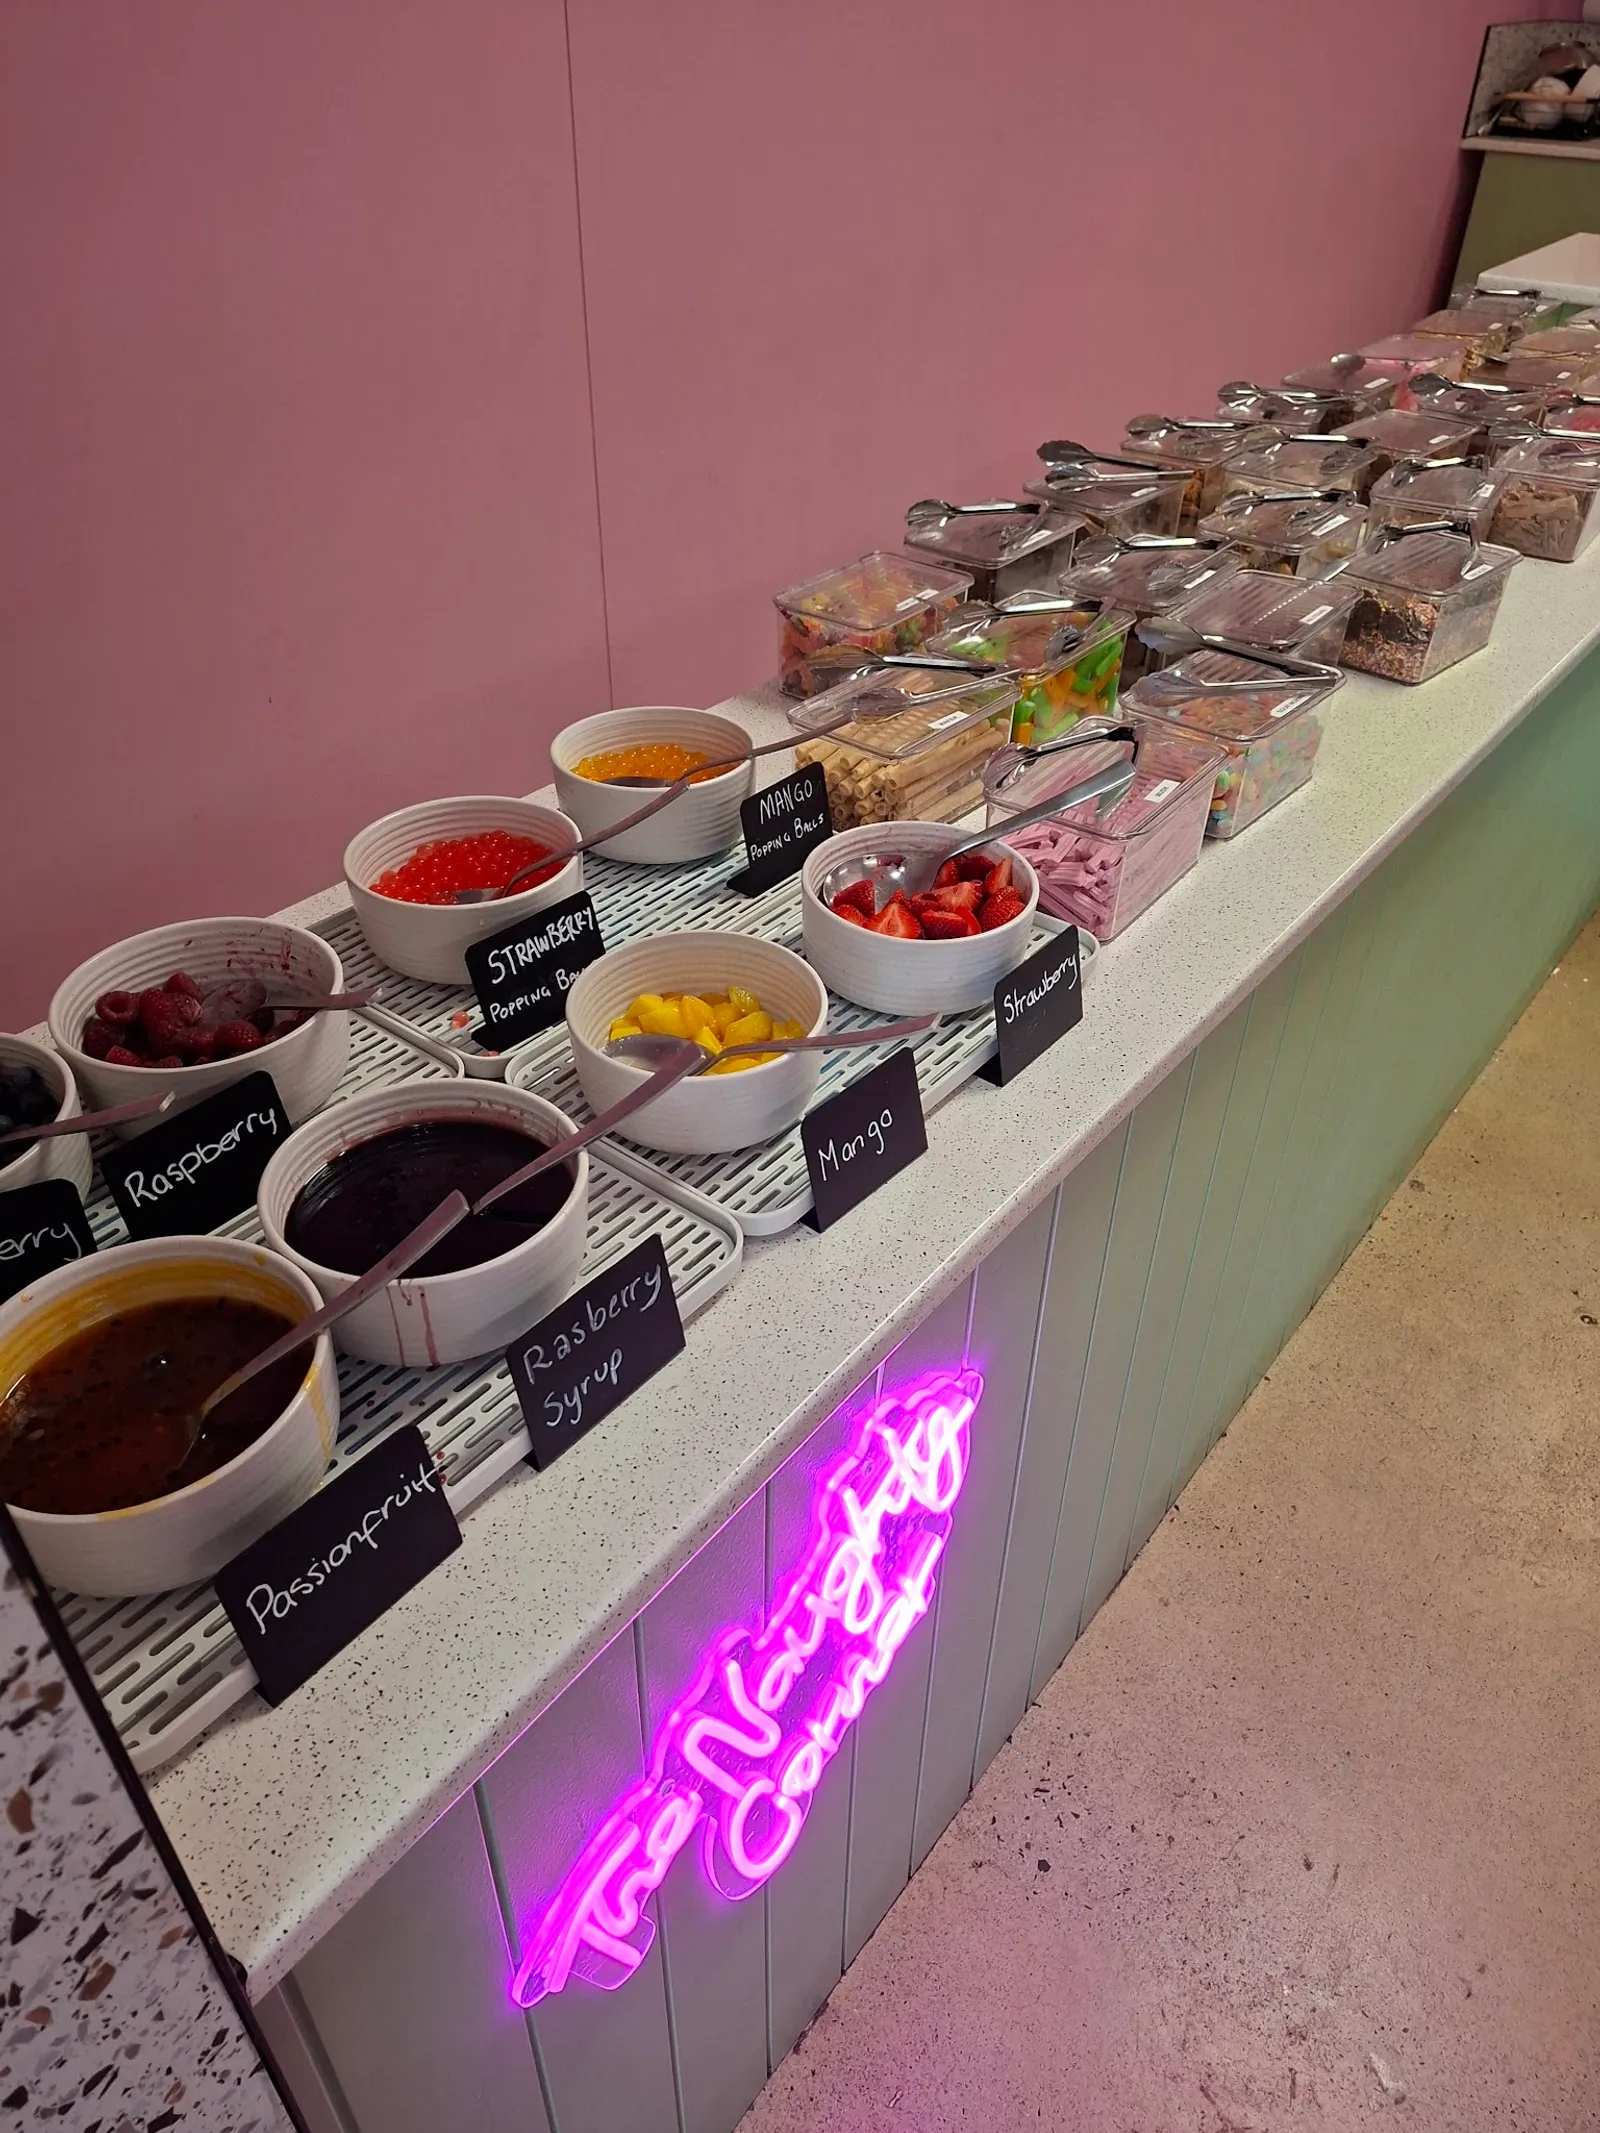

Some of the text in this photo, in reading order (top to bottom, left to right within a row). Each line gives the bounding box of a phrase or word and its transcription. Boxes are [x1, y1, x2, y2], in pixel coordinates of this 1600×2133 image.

[760, 779, 813, 825] MANGO
[488, 907, 594, 984] STRAWBERRY
[1003, 953, 1078, 1024] Strawberry
[489, 986, 551, 1023] POPPING
[124, 1108, 277, 1207] Raspberry
[818, 1109, 893, 1181] Mango
[523, 1264, 662, 1385] Rasberry
[246, 1463, 440, 1635] Passionfruit
[534, 1390, 974, 1995] The Naughty
[726, 1530, 944, 1880] Corner
